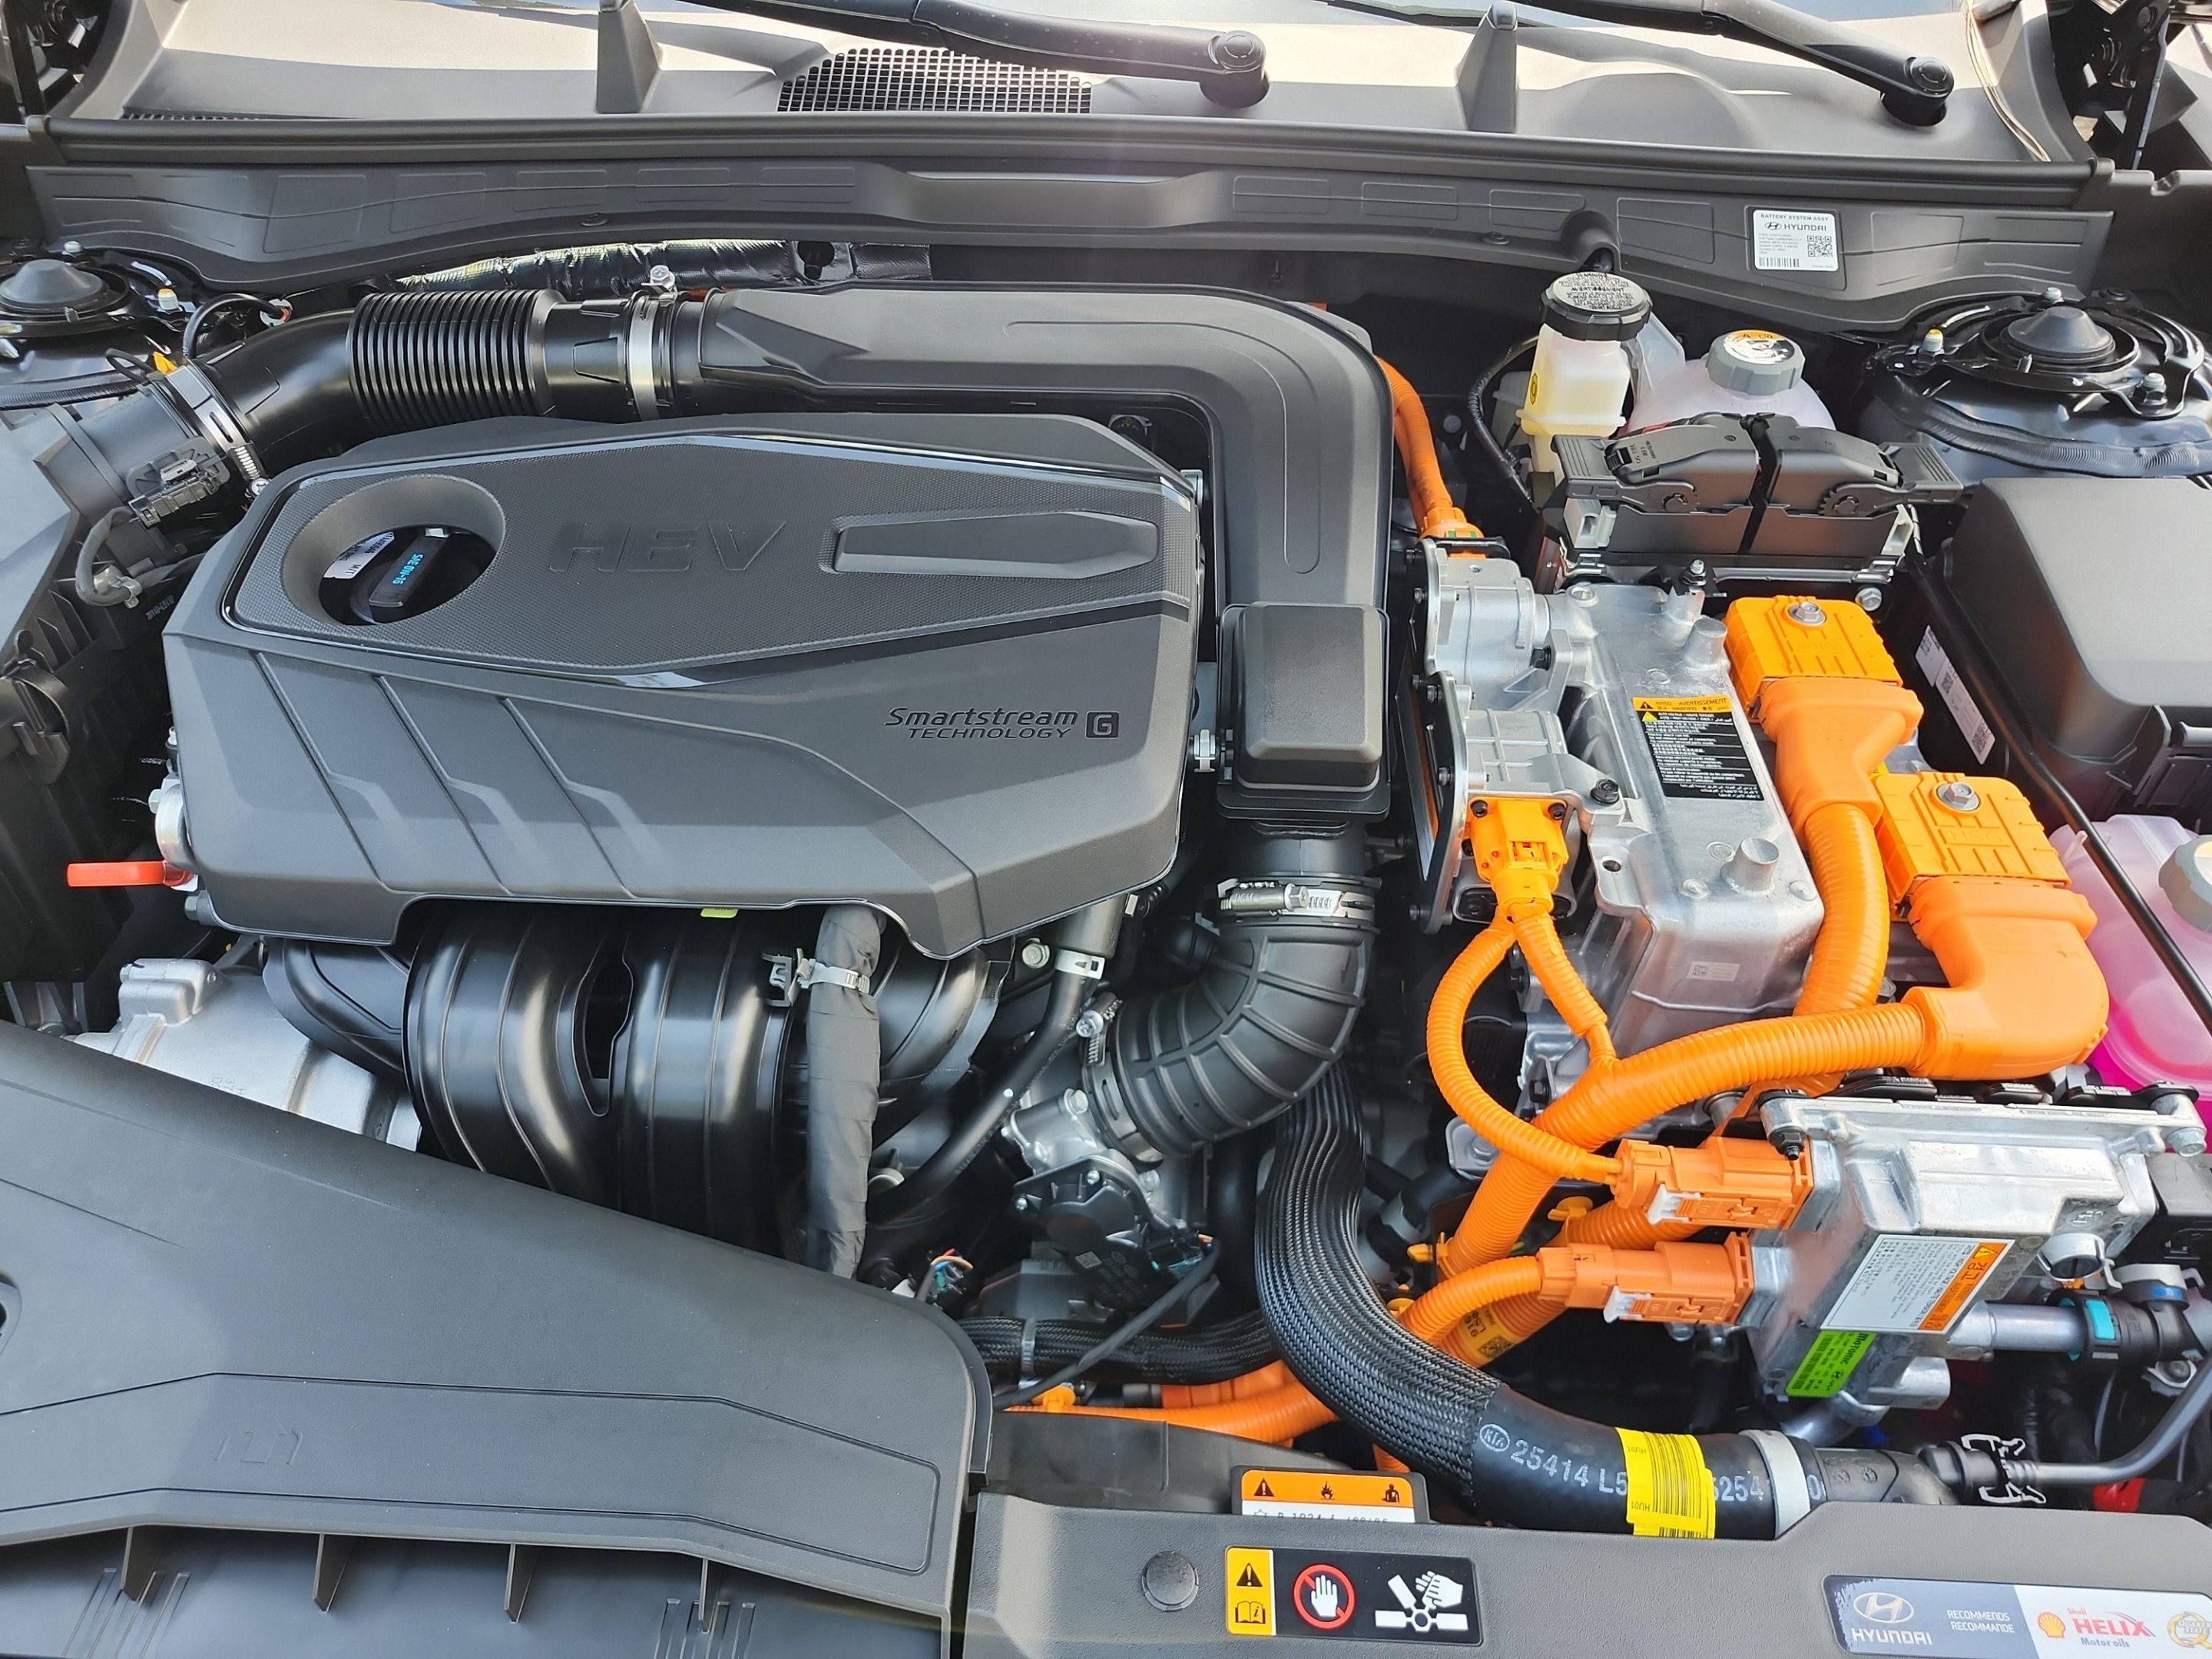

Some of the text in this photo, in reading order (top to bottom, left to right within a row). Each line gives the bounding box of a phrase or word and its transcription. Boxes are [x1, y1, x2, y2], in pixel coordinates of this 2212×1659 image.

[548, 522, 787, 572] HEV
[406, 553, 423, 566] SAE
[1679, 697, 1727, 706] AVERTISSEMENT
[884, 707, 1078, 726] Smartstream
[1090, 713, 1116, 737] G
[908, 728, 1071, 739] TECHNOLOGY
[1961, 1261, 1987, 1281] 경고
[1511, 1439, 1588, 1487] 25414
[1631, 1502, 1651, 1512] HU01
[1946, 1609, 2011, 1621] RECOMMENDS
[2067, 1608, 2088, 1616] Shell
[1950, 1621, 2016, 1634] RECOMMANDE
[2071, 1618, 2153, 1637] HELIX
[2177, 1621, 2212, 1629] QUAKER
[1851, 1628, 1932, 1646] HYUNDAI
[2081, 1637, 2131, 1648] Motor oils
